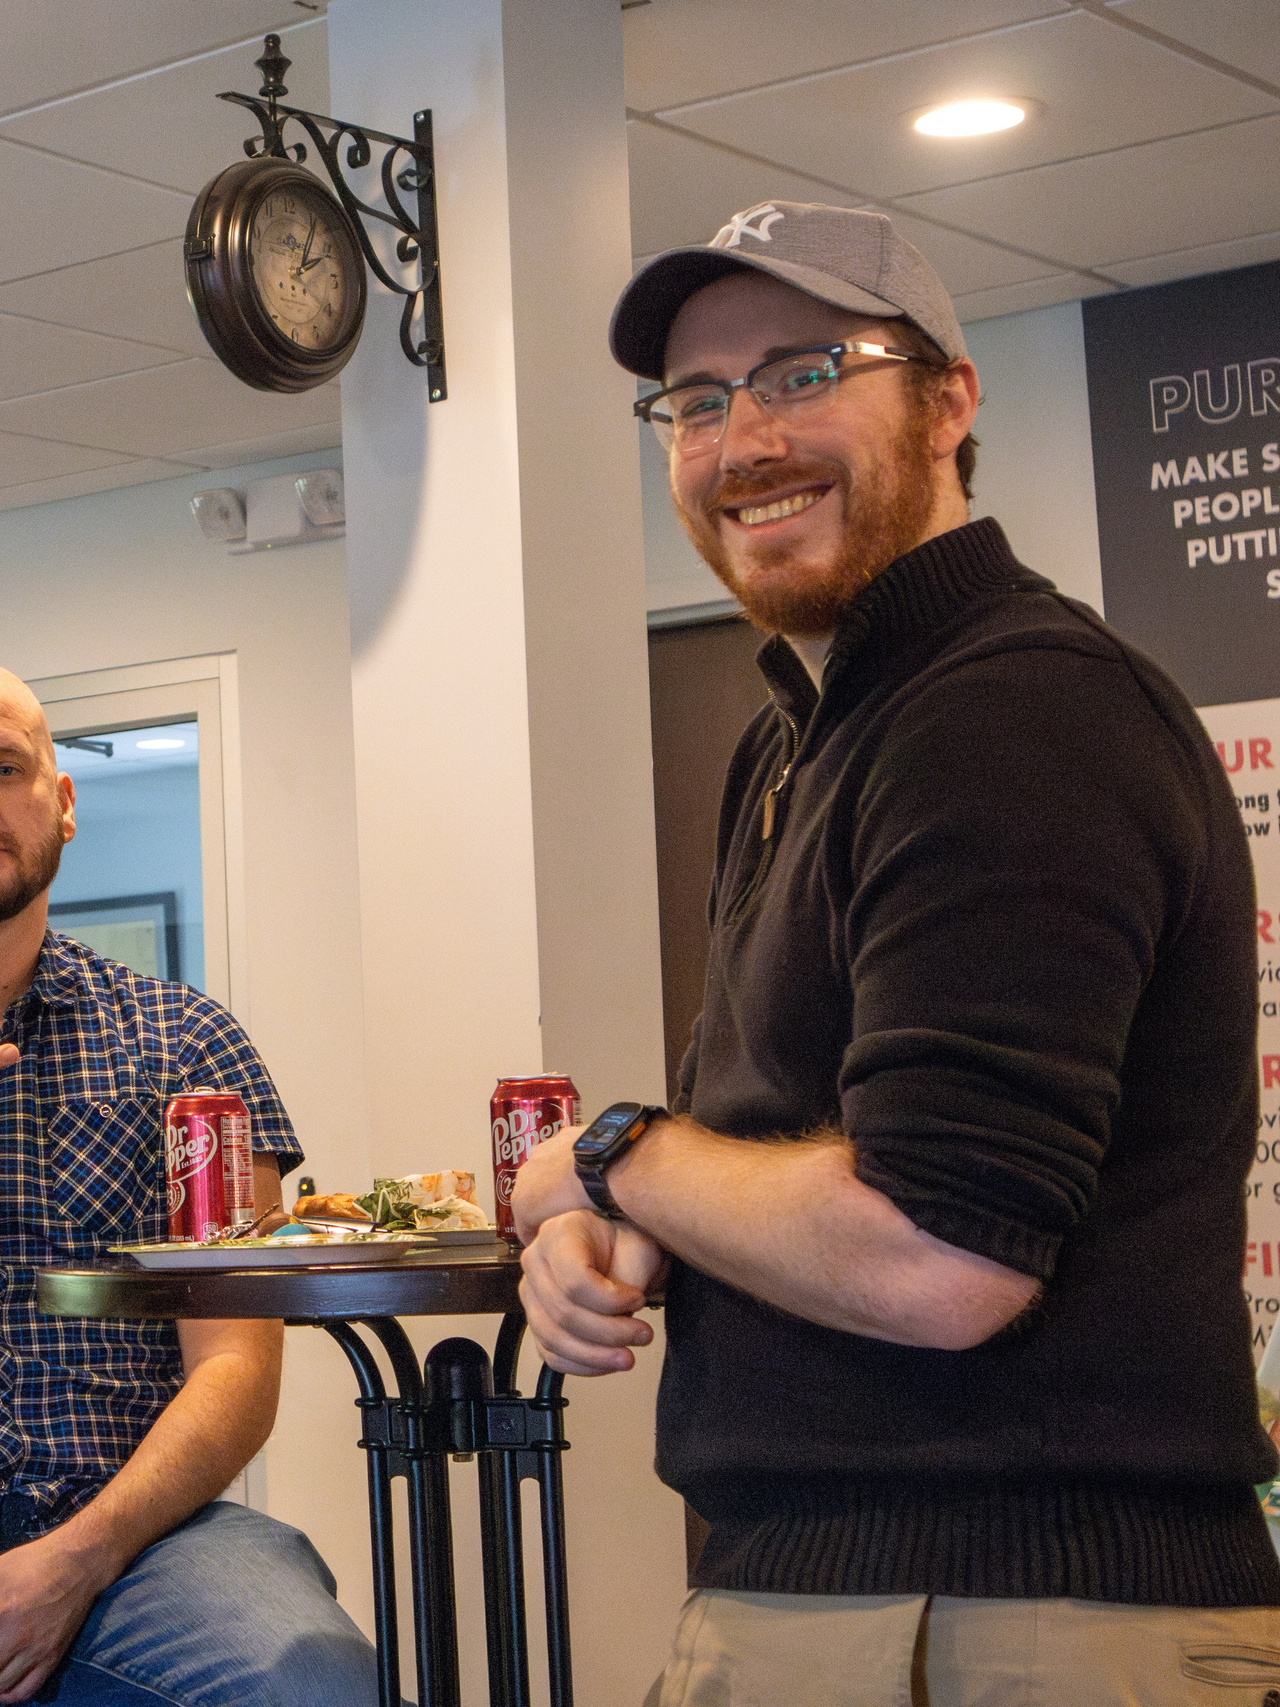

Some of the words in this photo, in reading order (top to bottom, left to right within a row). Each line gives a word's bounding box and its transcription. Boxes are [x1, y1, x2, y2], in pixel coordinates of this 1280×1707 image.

[1149, 357, 1280, 434] PUR
[1150, 447, 1250, 491] MAKE
[1173, 486, 1280, 529] PEOPL
[507, 1108, 543, 1140] Dr
